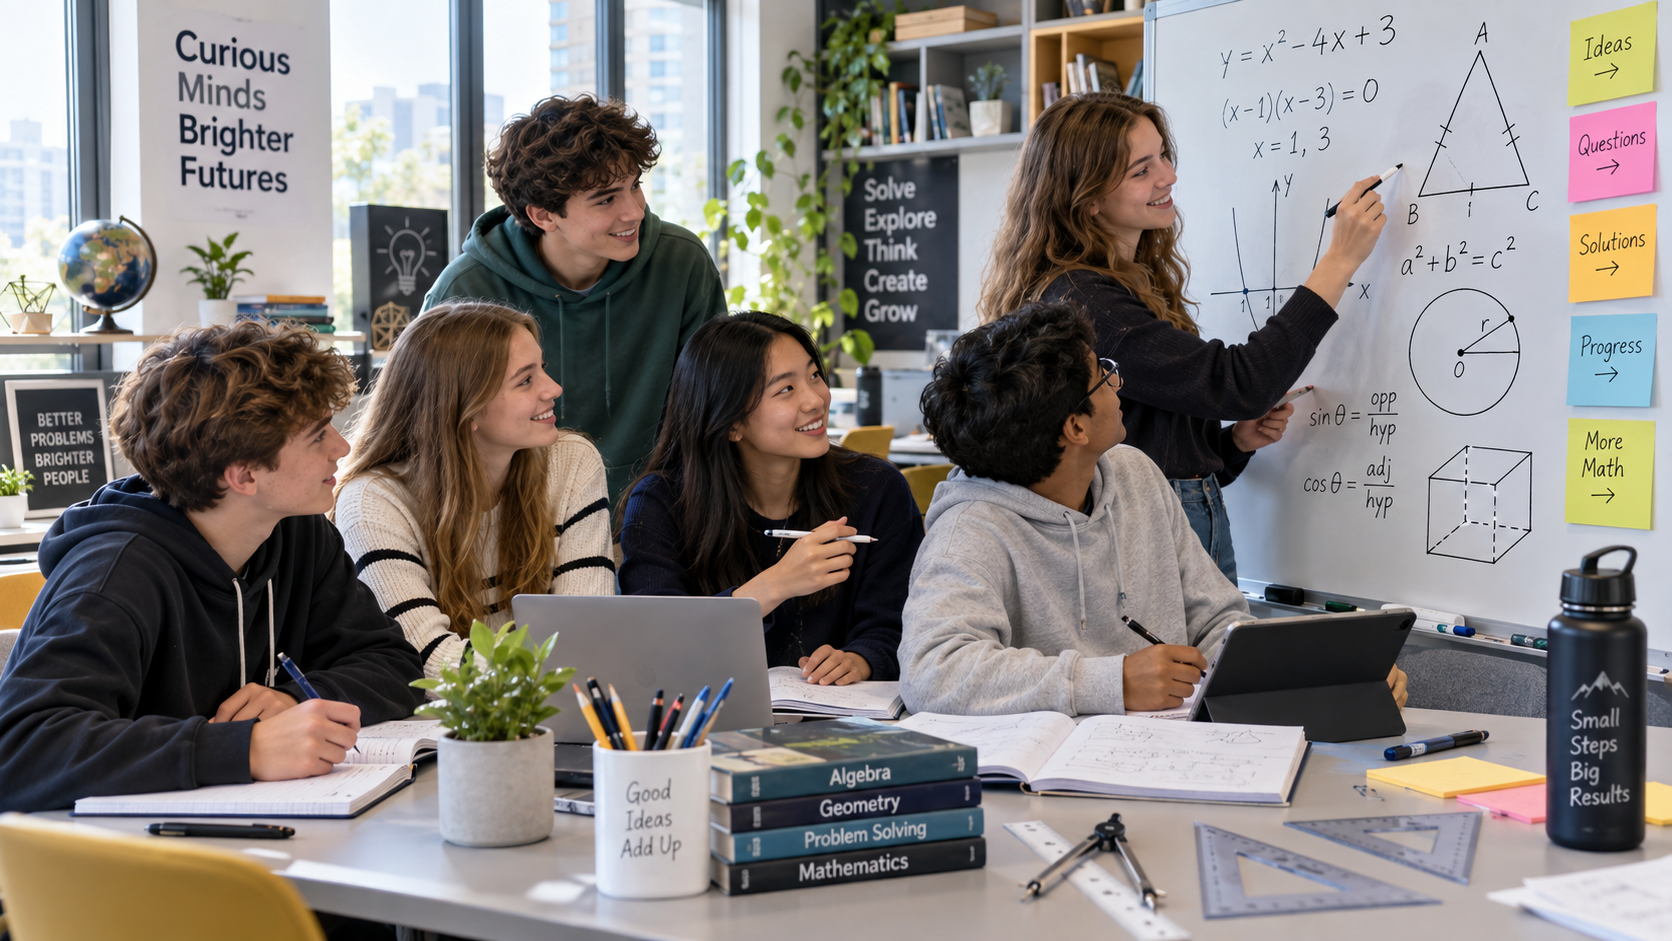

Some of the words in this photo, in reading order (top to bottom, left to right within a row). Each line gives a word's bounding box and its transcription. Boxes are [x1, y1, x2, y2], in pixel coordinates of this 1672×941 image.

[1474, 21, 1489, 45] A
[175, 30, 291, 75] Curious
[1221, 50, 1232, 79] y
[1379, 14, 1396, 46] 3
[1583, 35, 1632, 61] Ideas
[178, 72, 267, 111] Minds
[179, 113, 294, 157] Brighter
[1318, 126, 1331, 151] 3
[1579, 130, 1646, 157] Questions
[180, 156, 288, 193] Futures
[864, 176, 916, 202] Solve
[1526, 190, 1539, 211] C
[864, 206, 937, 236] Explore
[1407, 203, 1419, 225] B
[864, 237, 918, 262] Think
[1579, 231, 1646, 256] Solutions
[864, 268, 928, 292] Create
[864, 298, 918, 322] Grow
[1481, 318, 1490, 333] r
[1580, 334, 1642, 362] Progress
[1370, 391, 1397, 412] opp
[37, 411, 83, 427] BETTER
[1309, 407, 1330, 426] sin
[30, 430, 95, 447] PROBLEMS
[1369, 417, 1397, 445] hyp
[1585, 430, 1623, 451] More
[35, 450, 94, 467] BRIGHTER
[1366, 455, 1391, 484] adj
[1582, 457, 1625, 478] Math
[43, 469, 90, 486] PEOPLE
[1303, 477, 1327, 493] cos
[1365, 489, 1393, 519] hyp
[1571, 708, 1620, 730] Small
[1570, 736, 1618, 759] Steps
[829, 765, 892, 788] Algebra
[1570, 761, 1600, 785] Big
[627, 778, 671, 805] Good
[1570, 784, 1630, 807] Results
[820, 795, 901, 816] Geometry
[626, 810, 672, 831] Ideas
[804, 829, 868, 848] Problem
[872, 822, 927, 840] Solving
[620, 836, 654, 859] Add
[660, 835, 682, 862] Up
[799, 854, 909, 881] Mathematics
